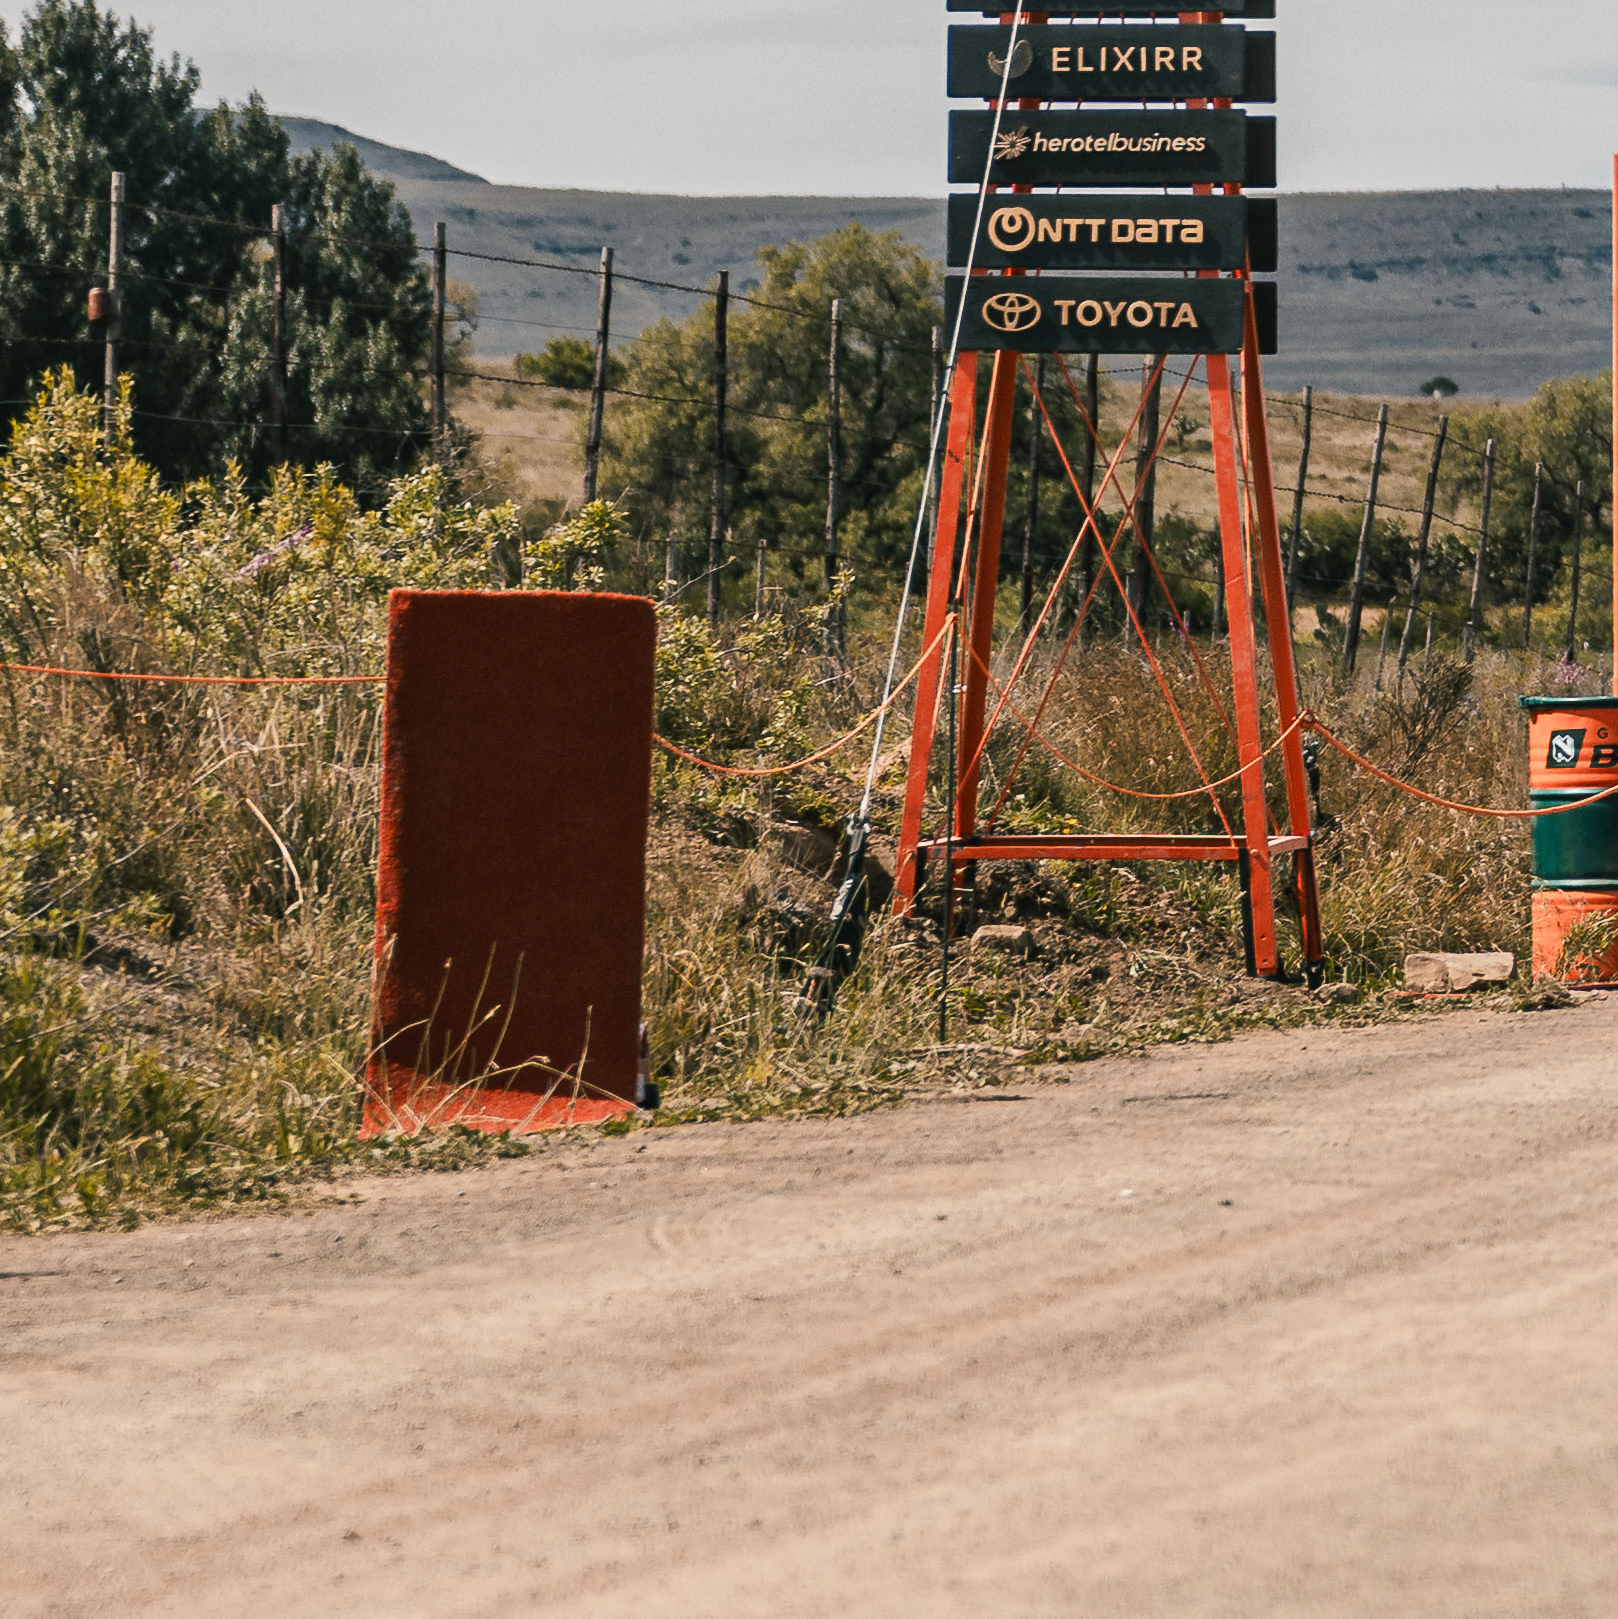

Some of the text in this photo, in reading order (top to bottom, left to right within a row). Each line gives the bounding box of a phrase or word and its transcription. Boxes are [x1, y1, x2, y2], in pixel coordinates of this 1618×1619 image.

[1051, 46, 1203, 72] ELIXIRR
[1038, 218, 1106, 243] NTT
[1053, 299, 1198, 328] TOYOTA
